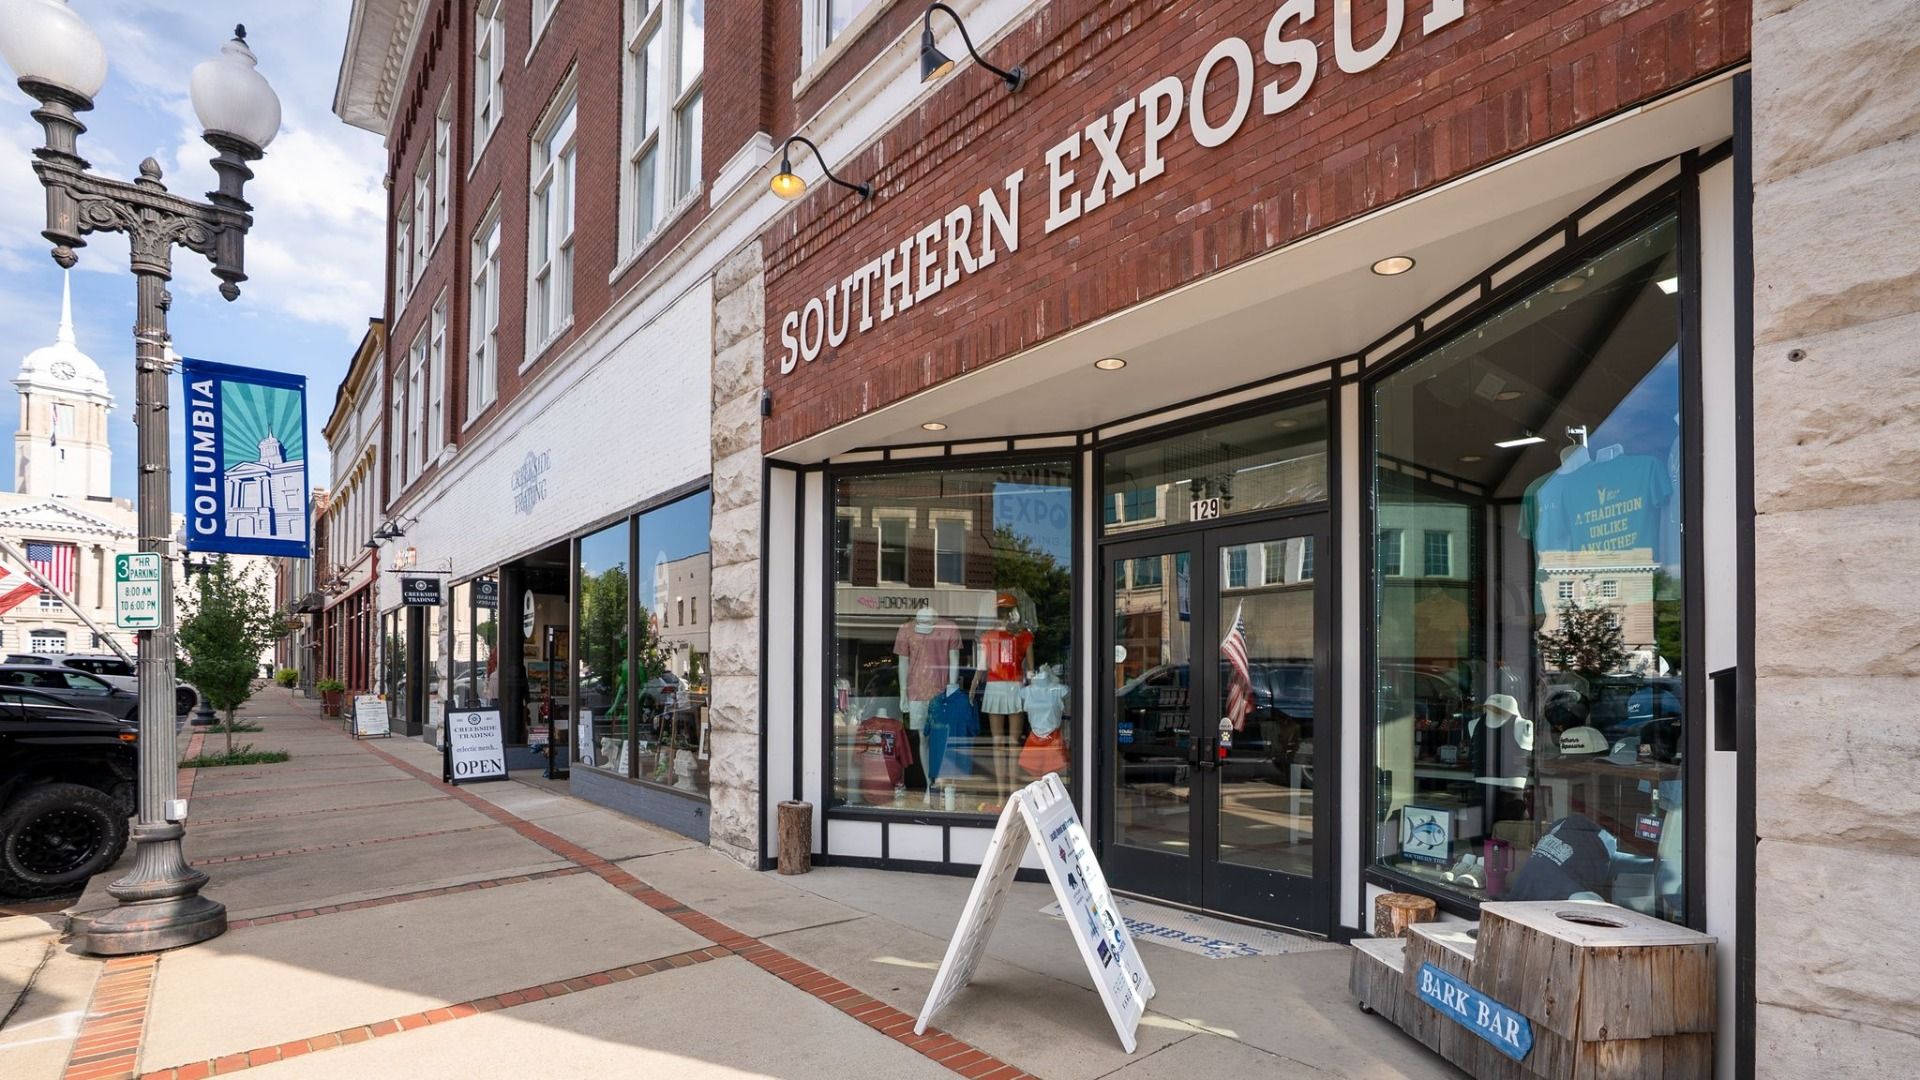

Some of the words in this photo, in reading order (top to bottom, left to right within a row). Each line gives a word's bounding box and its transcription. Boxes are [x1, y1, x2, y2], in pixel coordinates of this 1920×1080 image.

[780, 168, 1024, 375] SOUTHERN
[1045, 0, 1465, 234] EXPOSU
[191, 379, 218, 535] COLUMBIA
[1192, 499, 1218, 520] 129
[1584, 497, 1642, 523] TRADITION
[1589, 518, 1628, 538] UNLIKE
[118, 559, 130, 578] 3
[138, 557, 150, 567] HR
[130, 568, 158, 579] PARKING
[142, 586, 152, 596] AM
[121, 601, 129, 610] TO
[147, 600, 156, 610] PM
[456, 758, 502, 775] OPEN
[1421, 968, 1471, 1017] BARK
[1477, 1000, 1520, 1048] BAR
